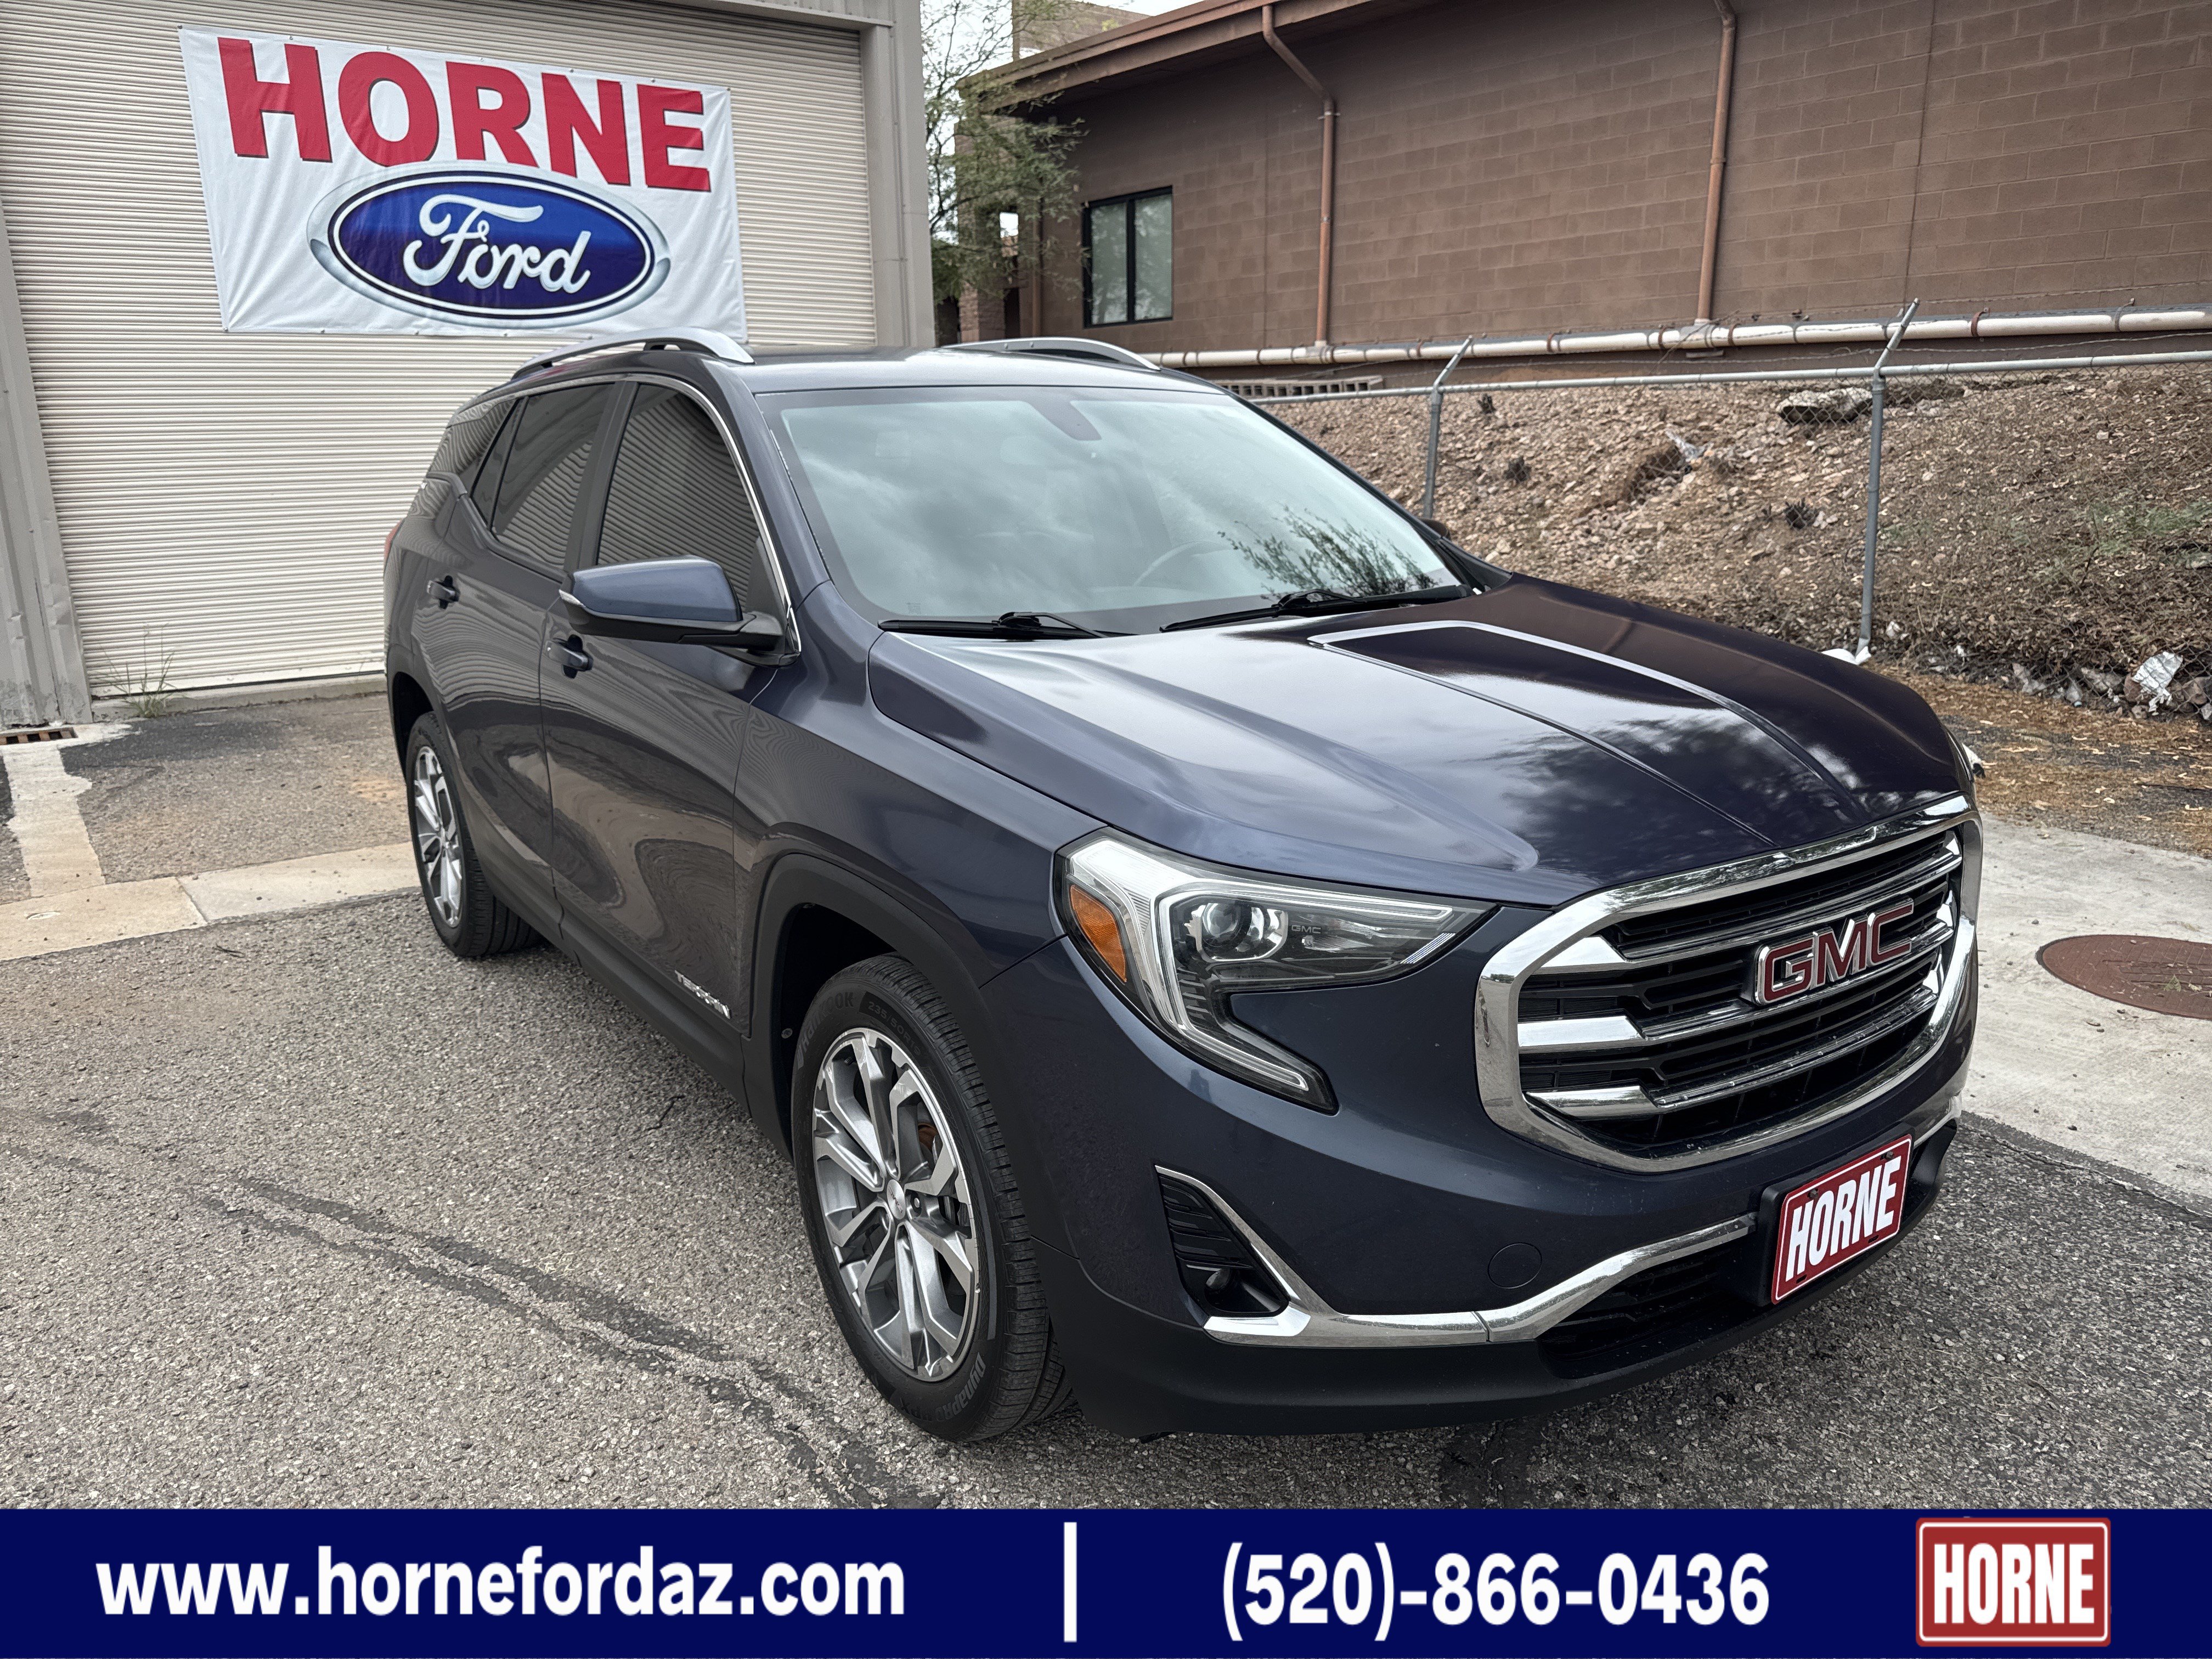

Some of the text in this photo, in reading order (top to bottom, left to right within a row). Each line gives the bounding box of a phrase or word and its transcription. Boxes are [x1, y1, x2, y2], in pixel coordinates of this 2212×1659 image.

[218, 37, 712, 193] HORNE
[403, 193, 591, 294] Ford
[1291, 924, 1321, 934] GMC
[1756, 897, 1914, 1005] GMC
[1785, 1155, 1901, 1282] HORNE
